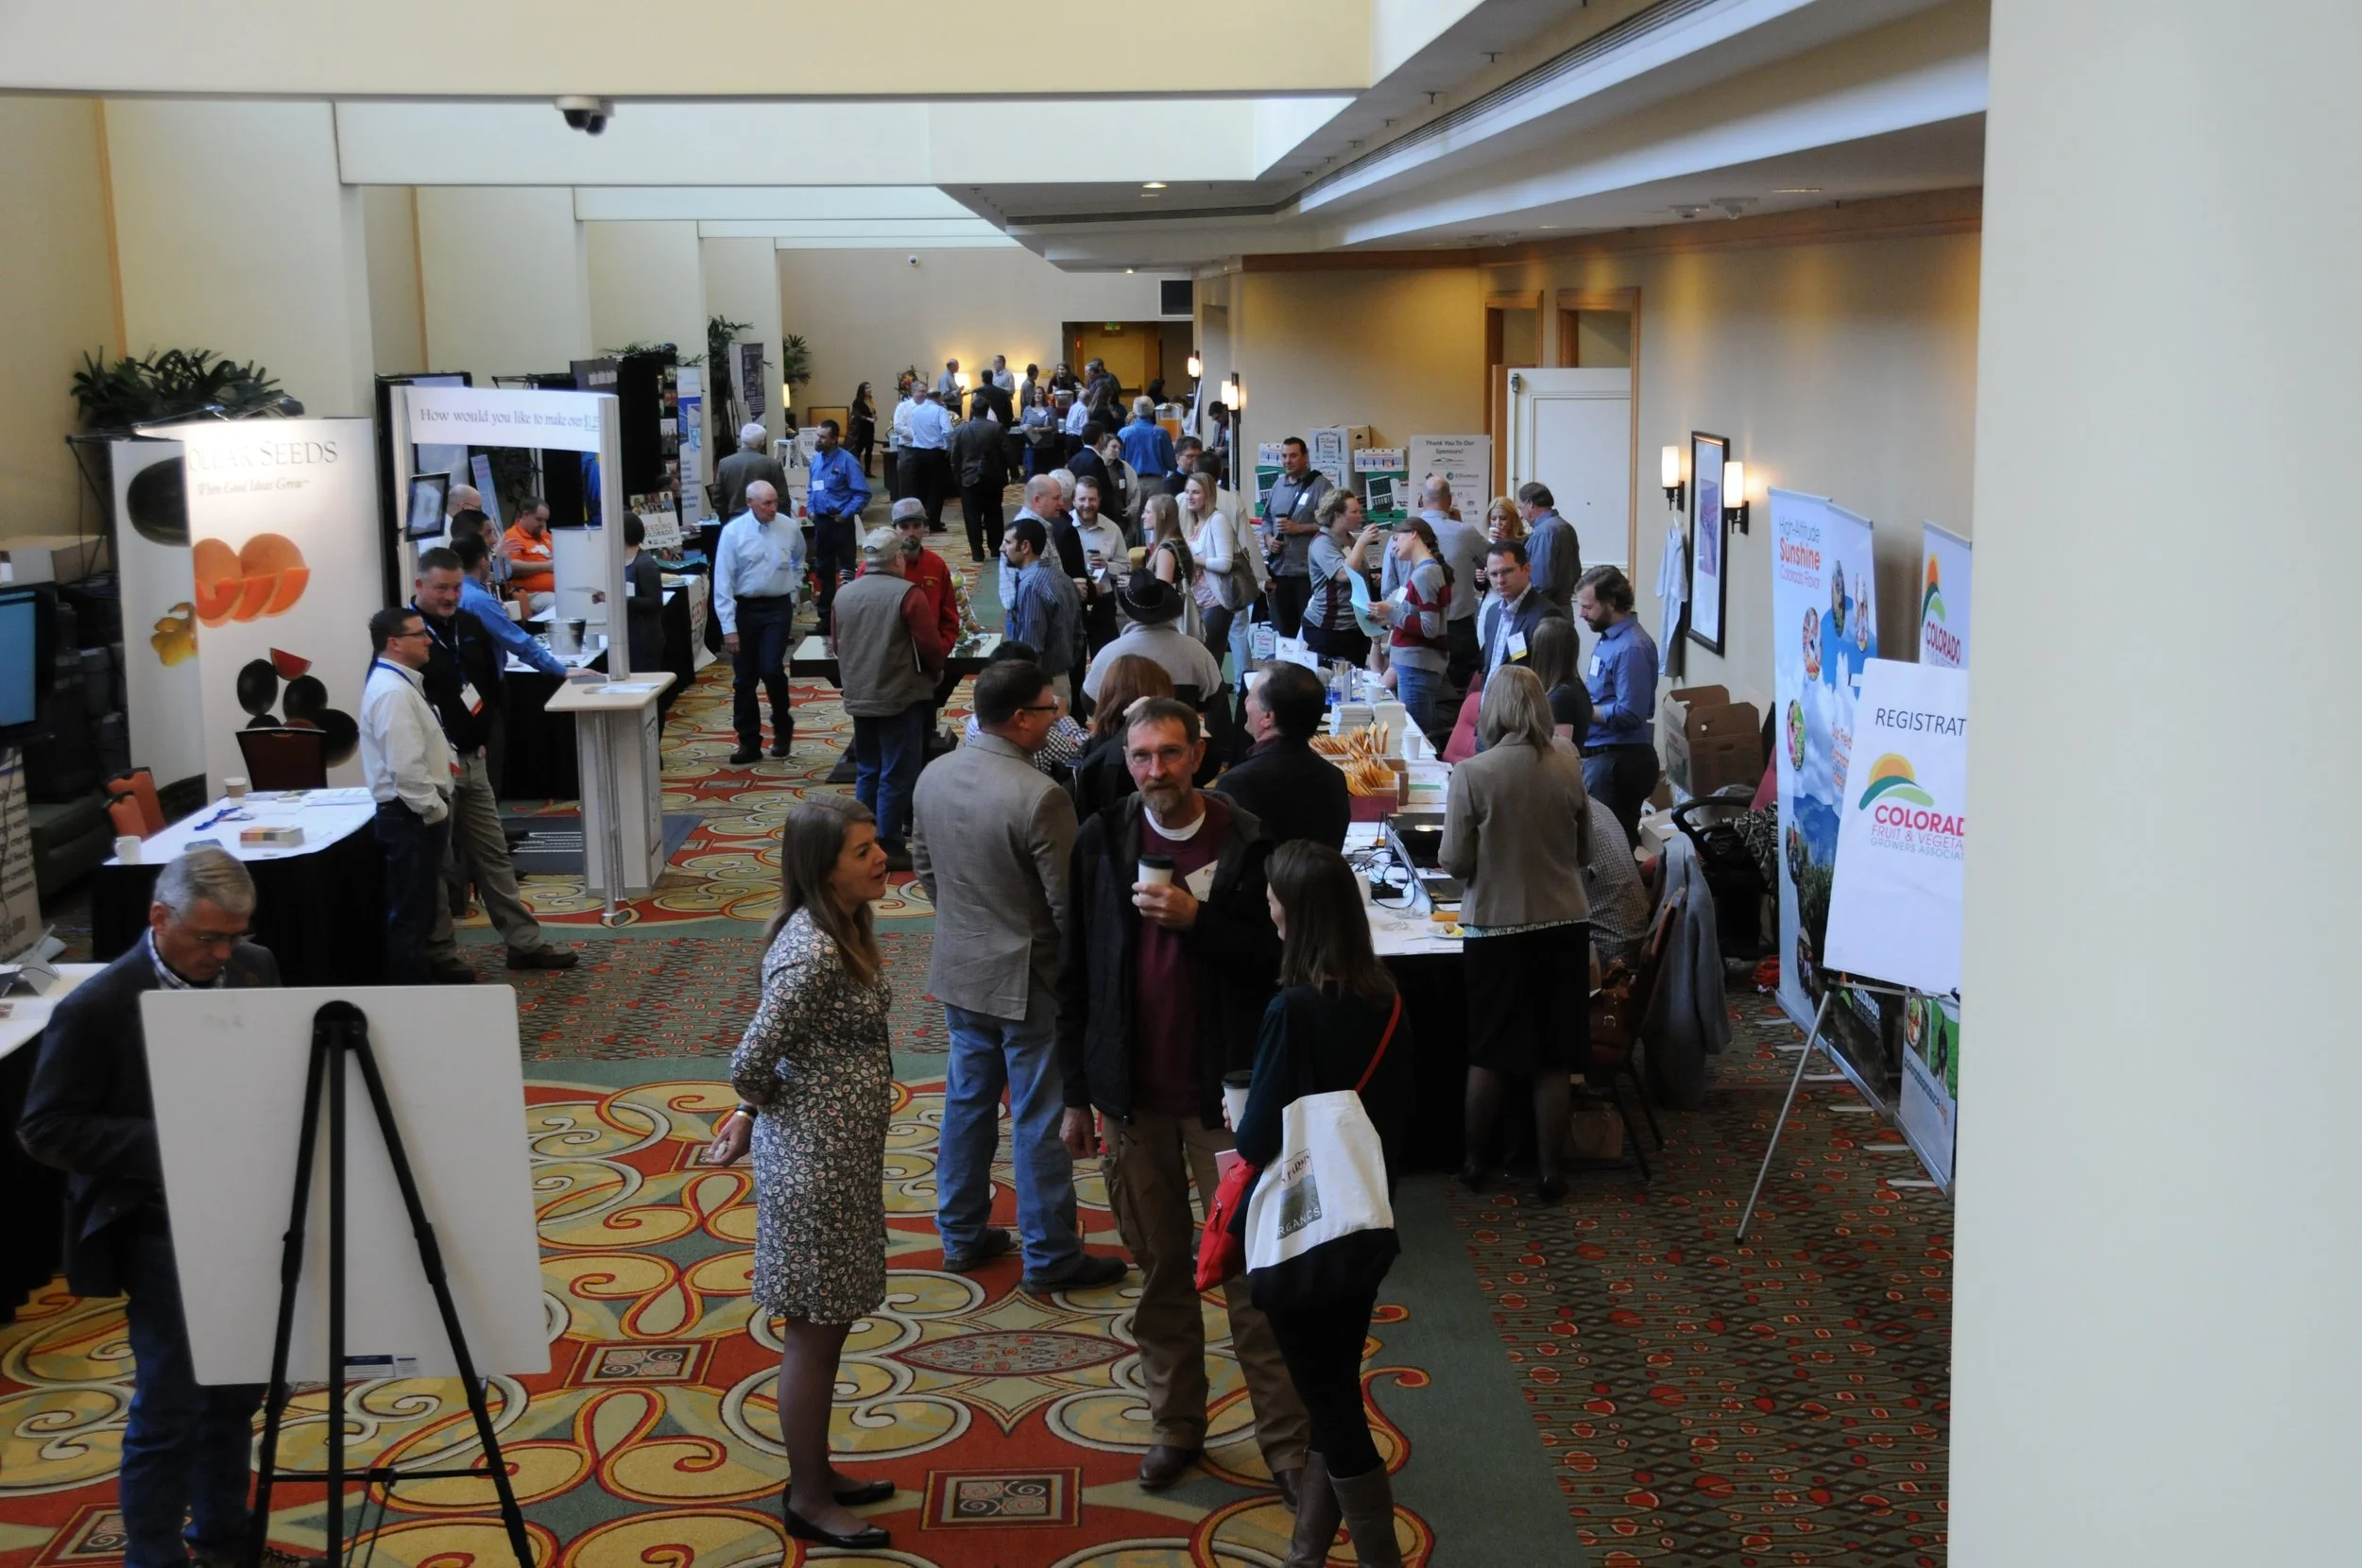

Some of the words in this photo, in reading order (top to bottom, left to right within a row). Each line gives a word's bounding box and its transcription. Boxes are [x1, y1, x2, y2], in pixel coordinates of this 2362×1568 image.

[419, 408, 450, 421] How
[453, 409, 489, 423] would
[491, 412, 511, 427] you
[513, 410, 532, 424] like
[533, 413, 543, 425] to
[545, 414, 567, 426] make
[567, 417, 583, 426] over
[259, 440, 338, 467] SEEDS
[644, 522, 672, 531] EEDING
[645, 529, 674, 537] OLORADO
[1779, 536, 1821, 571] Sunshine
[1926, 621, 1960, 665] COLORADO
[1874, 707, 1967, 737] REGISTRAT
[1870, 837, 1916, 853] GROWERS
[1871, 824, 1901, 841] FRUIT
[1905, 829, 1914, 843] &
[1917, 832, 1964, 850] VEGETA
